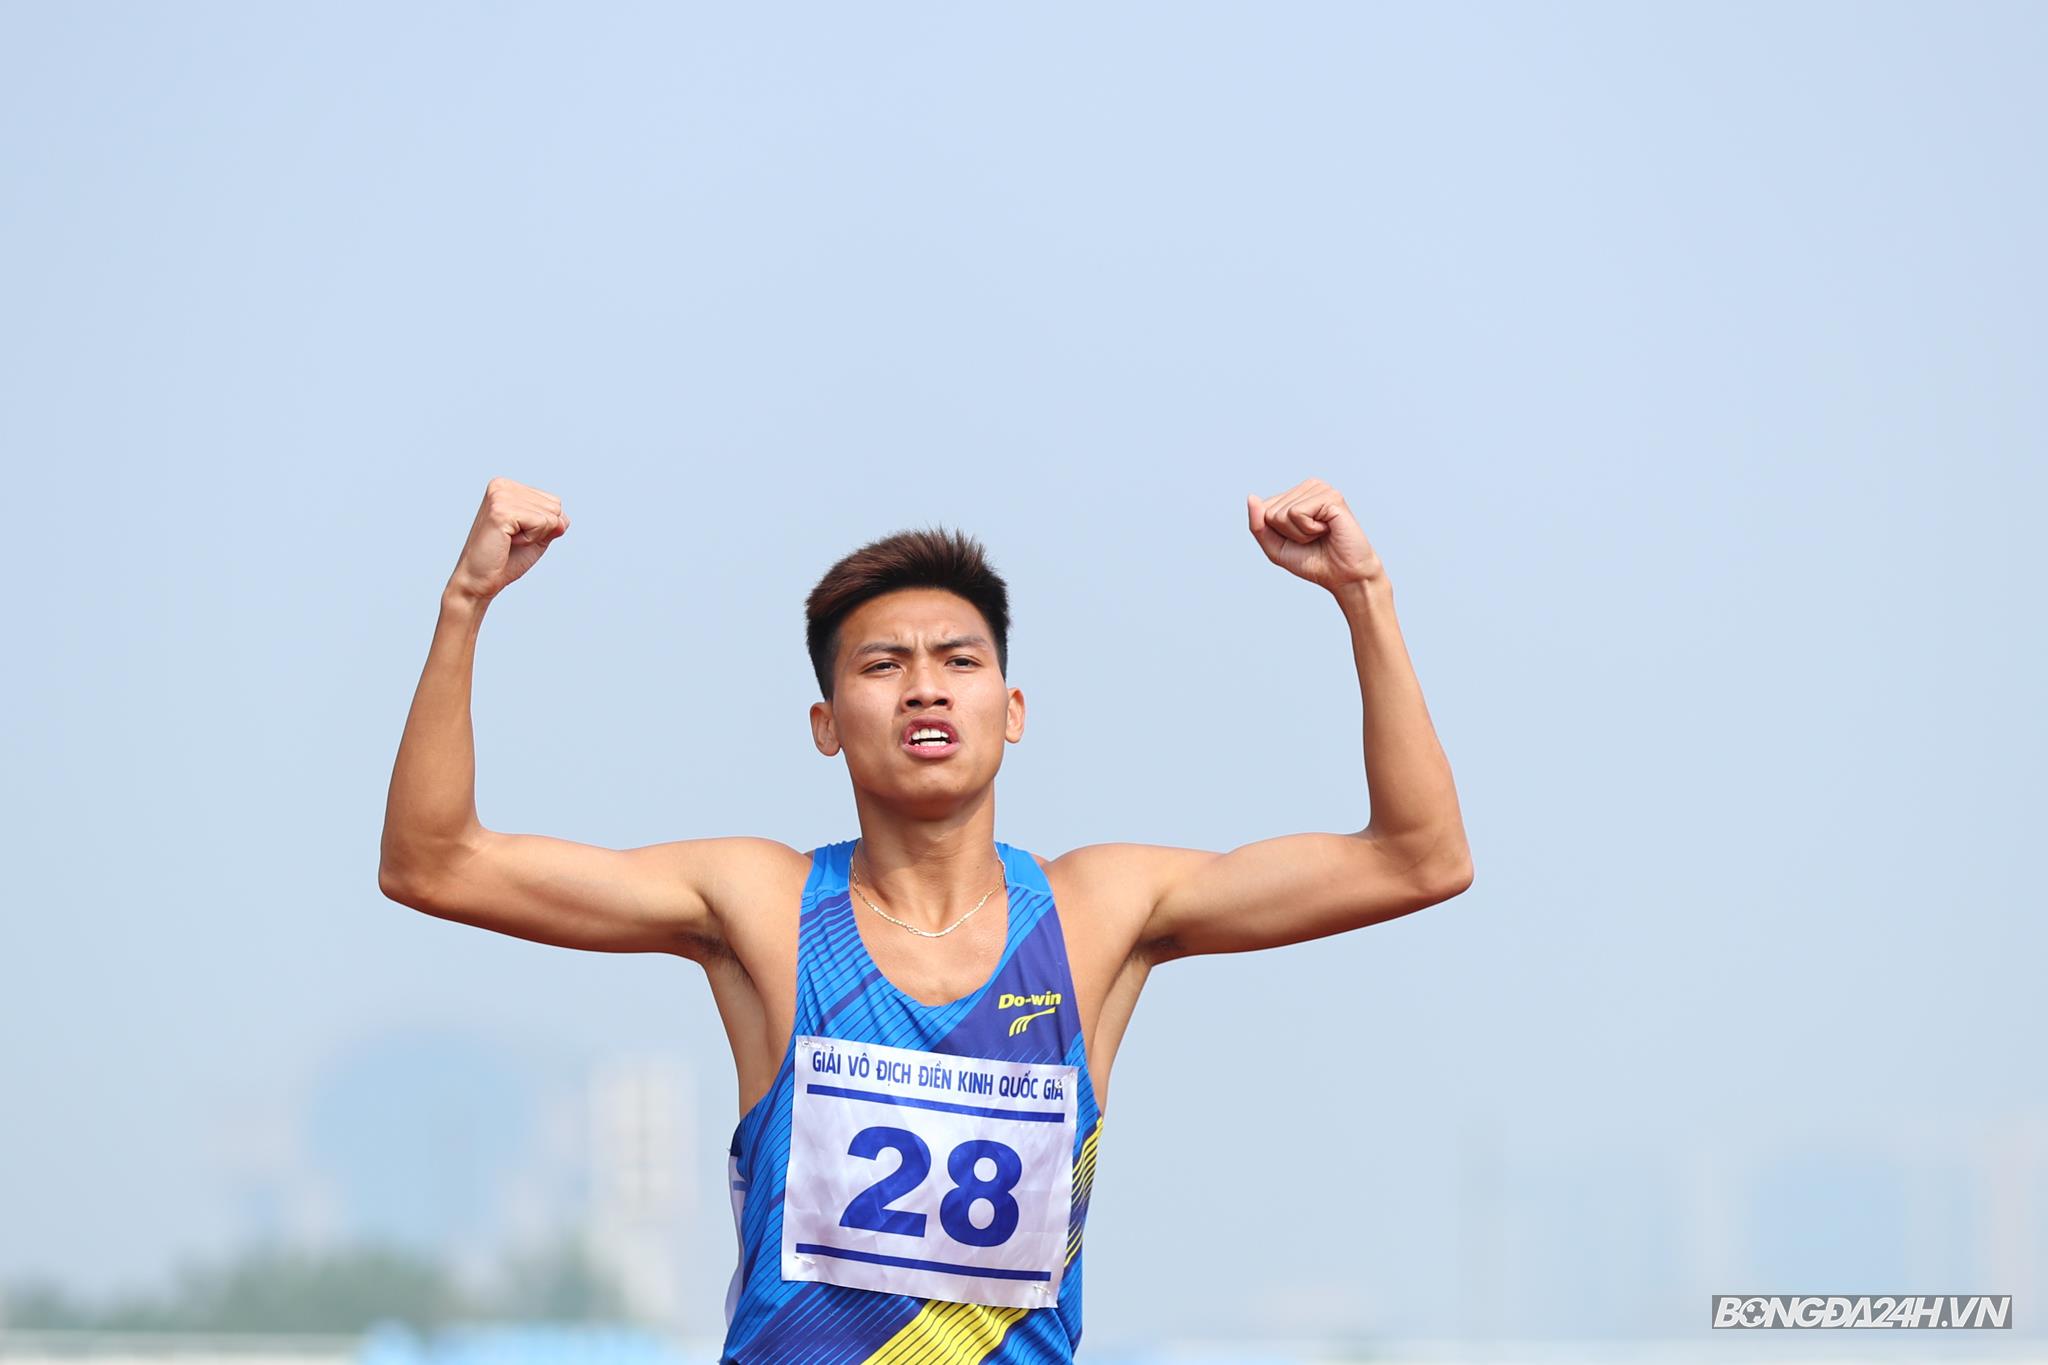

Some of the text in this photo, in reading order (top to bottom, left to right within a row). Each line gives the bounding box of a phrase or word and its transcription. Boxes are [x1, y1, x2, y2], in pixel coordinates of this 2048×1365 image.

[998, 990, 1062, 1009] Do-win
[812, 1045, 841, 1075] GIẢI
[847, 1052, 870, 1078] VÔ
[876, 1059, 911, 1087] ĐỊCH
[918, 1060, 952, 1090] ĐIỀN
[957, 1070, 994, 1096] KINH
[999, 1070, 1038, 1099] QUỐC
[839, 1126, 1023, 1247] 28
